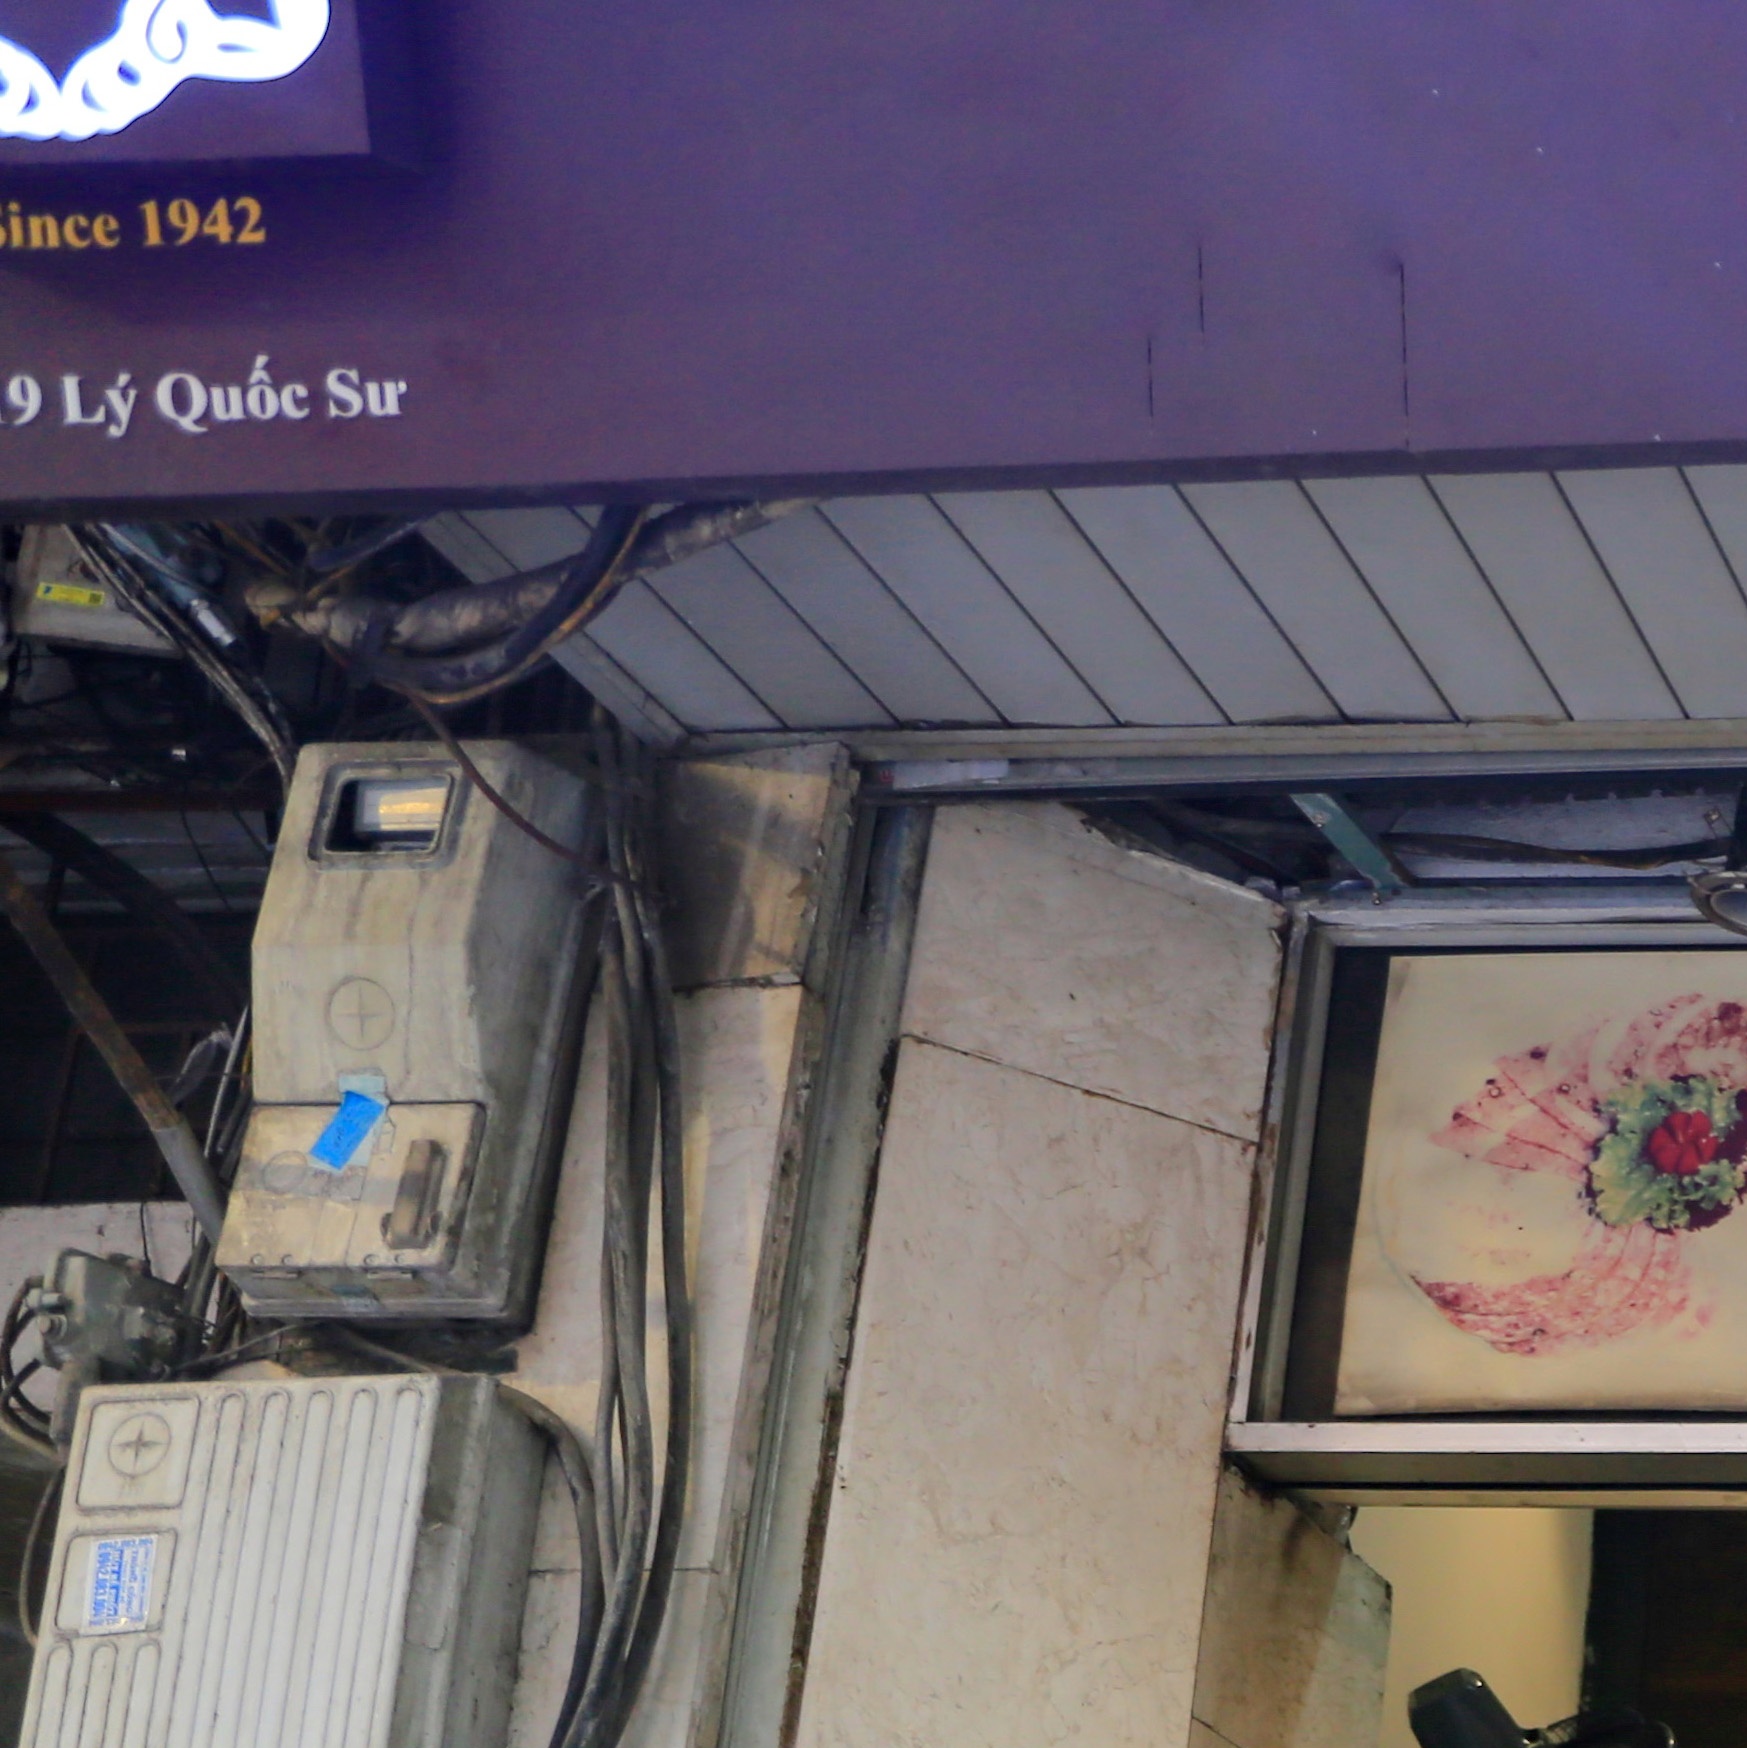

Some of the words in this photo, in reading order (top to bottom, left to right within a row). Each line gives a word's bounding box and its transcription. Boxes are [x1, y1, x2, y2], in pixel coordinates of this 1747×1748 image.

[138, 196, 267, 246] 1942
[62, 374, 137, 438] Lý
[155, 355, 310, 431] Quốc
[327, 368, 407, 420] Sư
